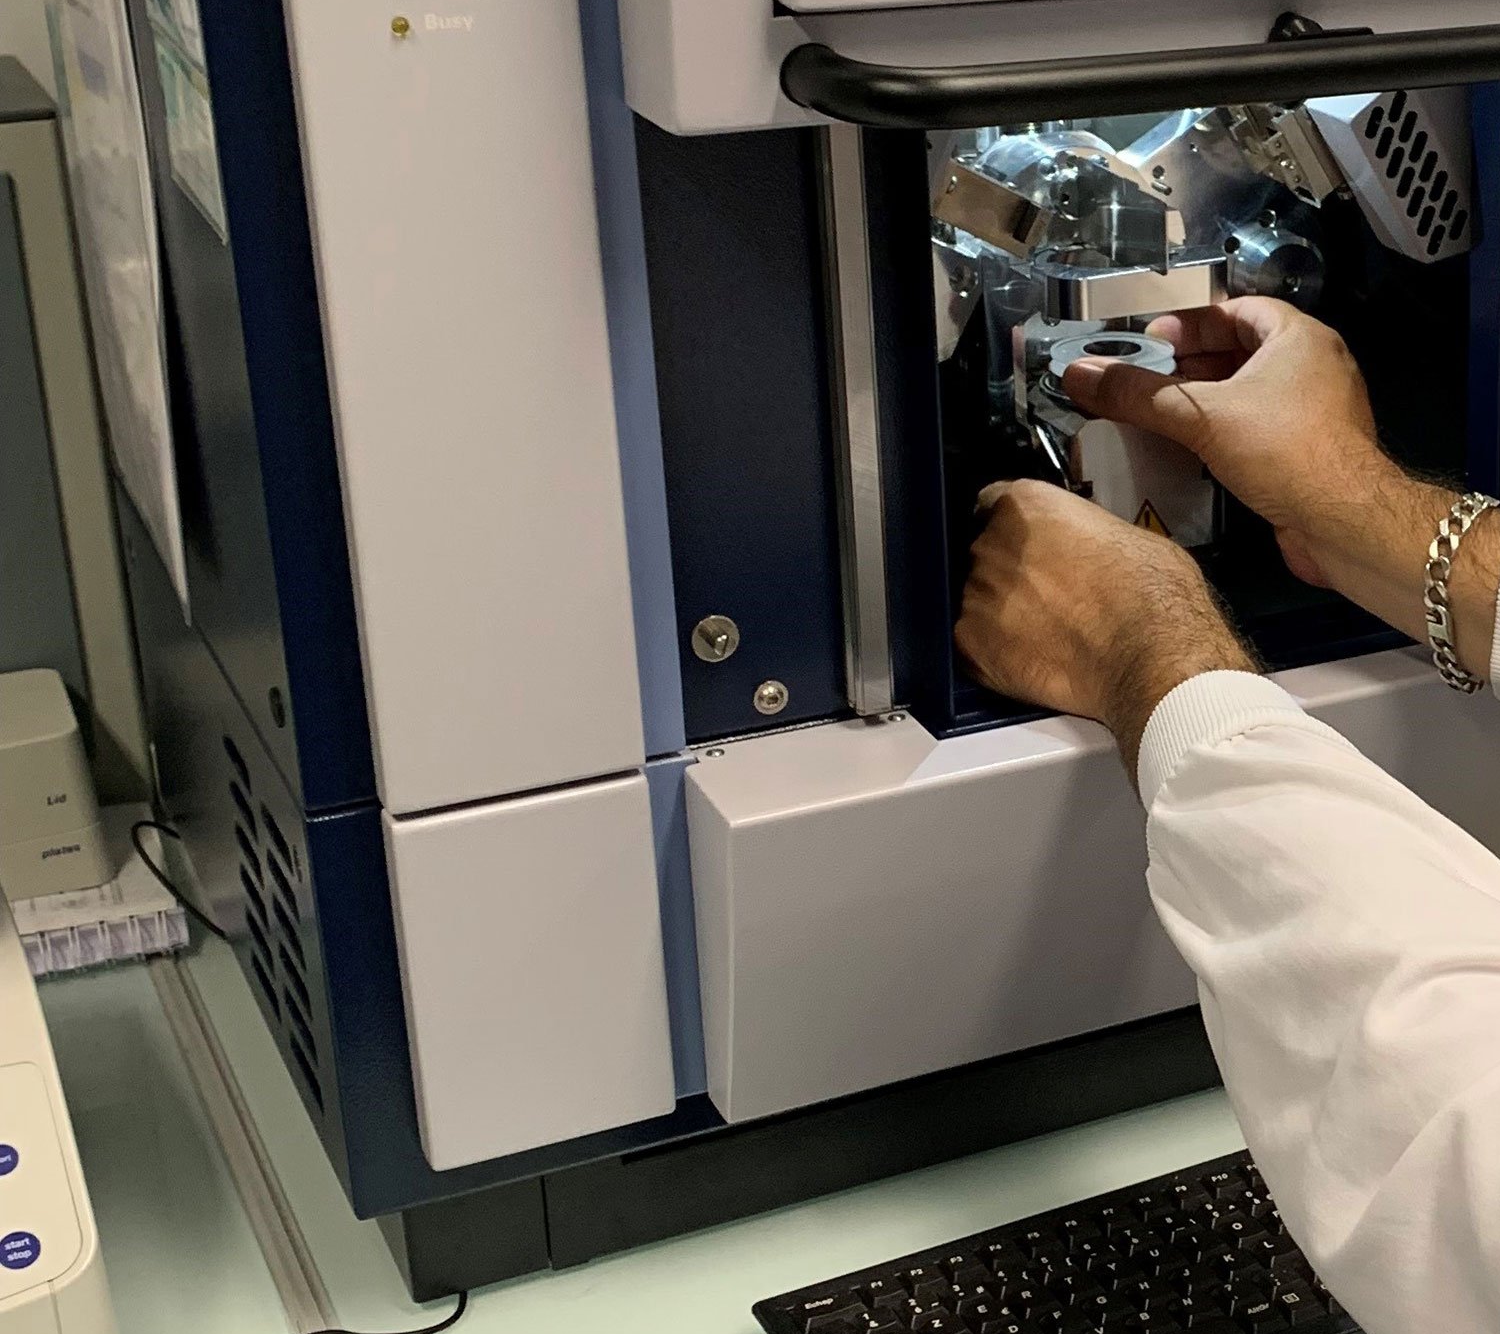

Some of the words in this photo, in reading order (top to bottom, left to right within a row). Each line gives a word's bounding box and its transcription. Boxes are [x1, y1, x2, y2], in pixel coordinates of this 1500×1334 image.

[424, 14, 474, 32] Busy
[47, 794, 67, 806] Lid
[4, 1238, 31, 1251] start
[7, 1249, 33, 1262] stop
[870, 1279, 884, 1289] F1
[931, 1318, 943, 1329] Z
